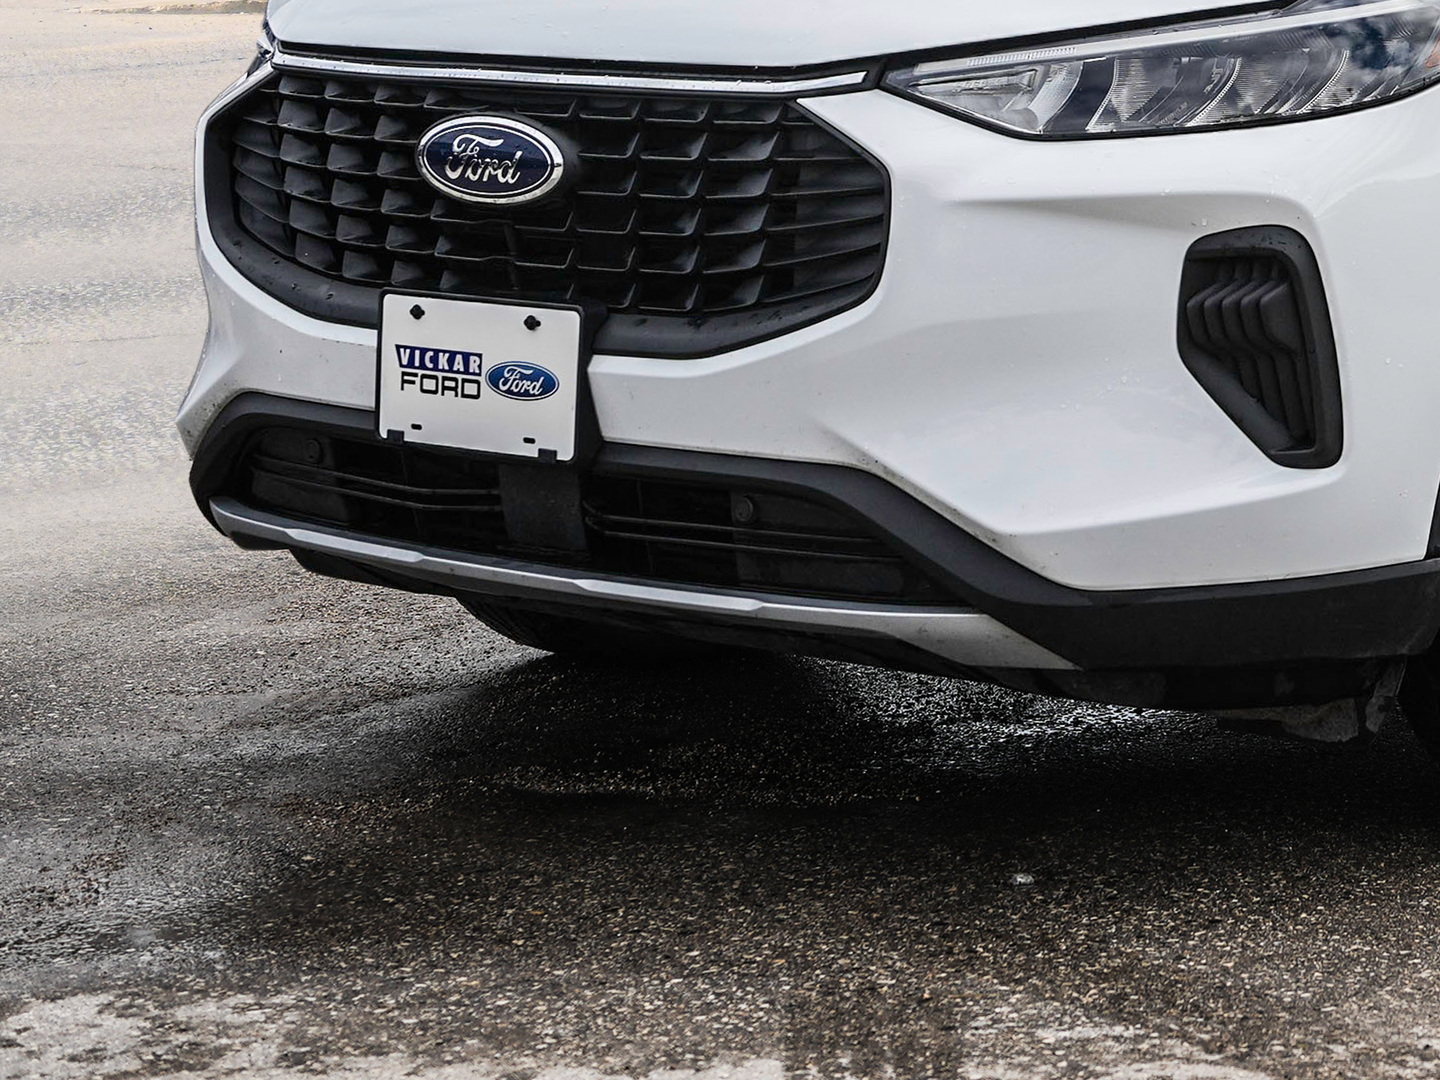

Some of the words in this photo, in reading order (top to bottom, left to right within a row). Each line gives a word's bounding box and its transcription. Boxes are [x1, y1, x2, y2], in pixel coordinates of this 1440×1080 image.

[445, 132, 523, 186] Ford
[399, 346, 482, 374] VICKAR
[400, 372, 482, 400] FORD
[498, 367, 545, 397] Ford
